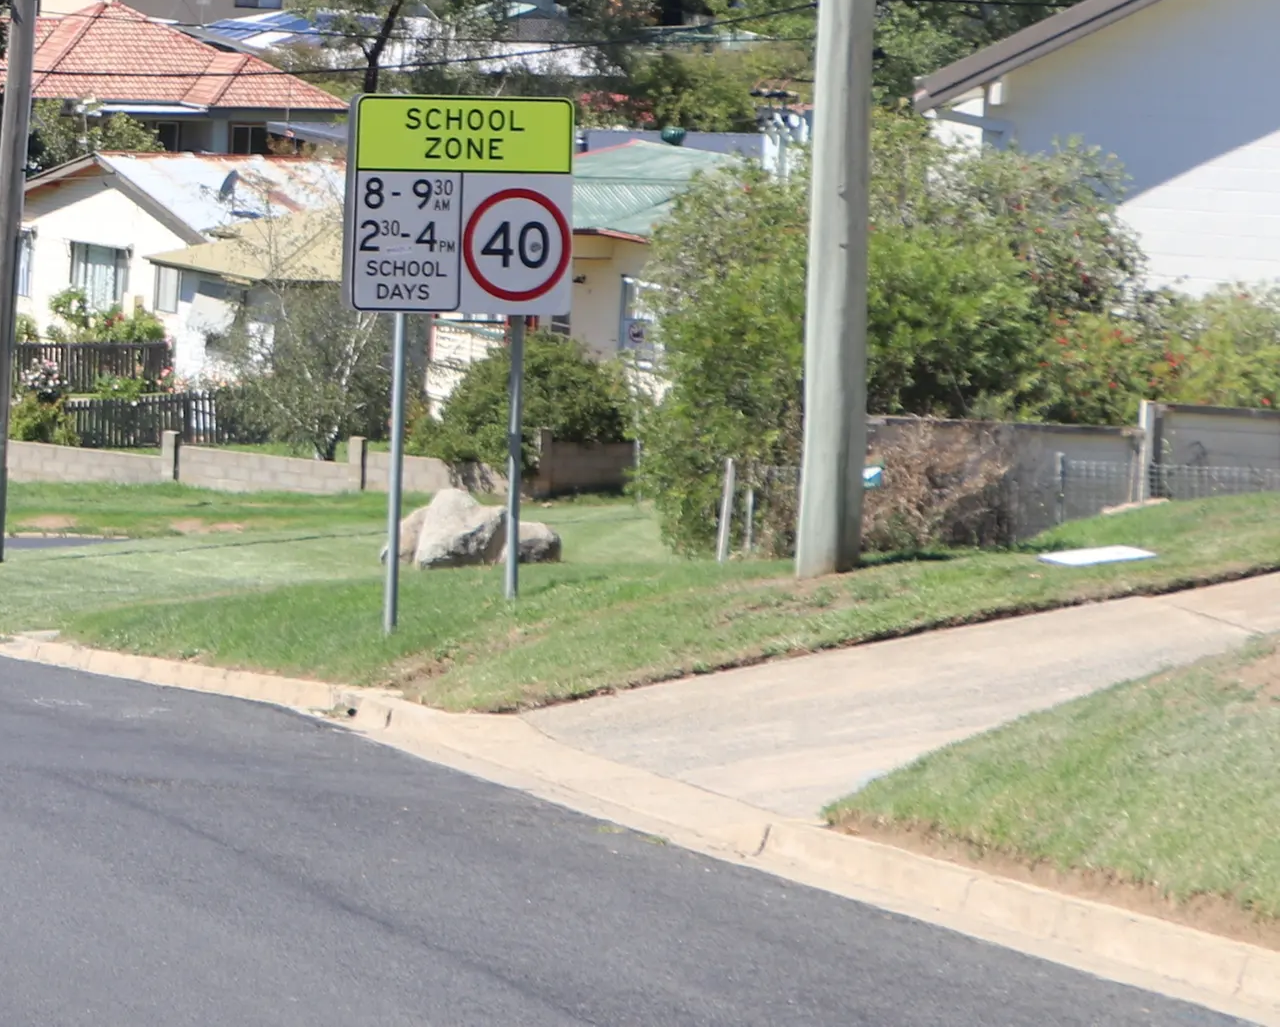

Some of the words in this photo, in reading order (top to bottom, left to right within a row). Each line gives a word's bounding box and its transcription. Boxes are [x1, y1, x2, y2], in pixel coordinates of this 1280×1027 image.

[405, 108, 525, 132] SCHOOL
[424, 137, 504, 160] ZONE
[434, 200, 450, 211] AM
[439, 241, 455, 253] PM
[481, 221, 550, 269] 40
[366, 260, 447, 278] SCHOOL
[376, 284, 430, 300] DAYS
